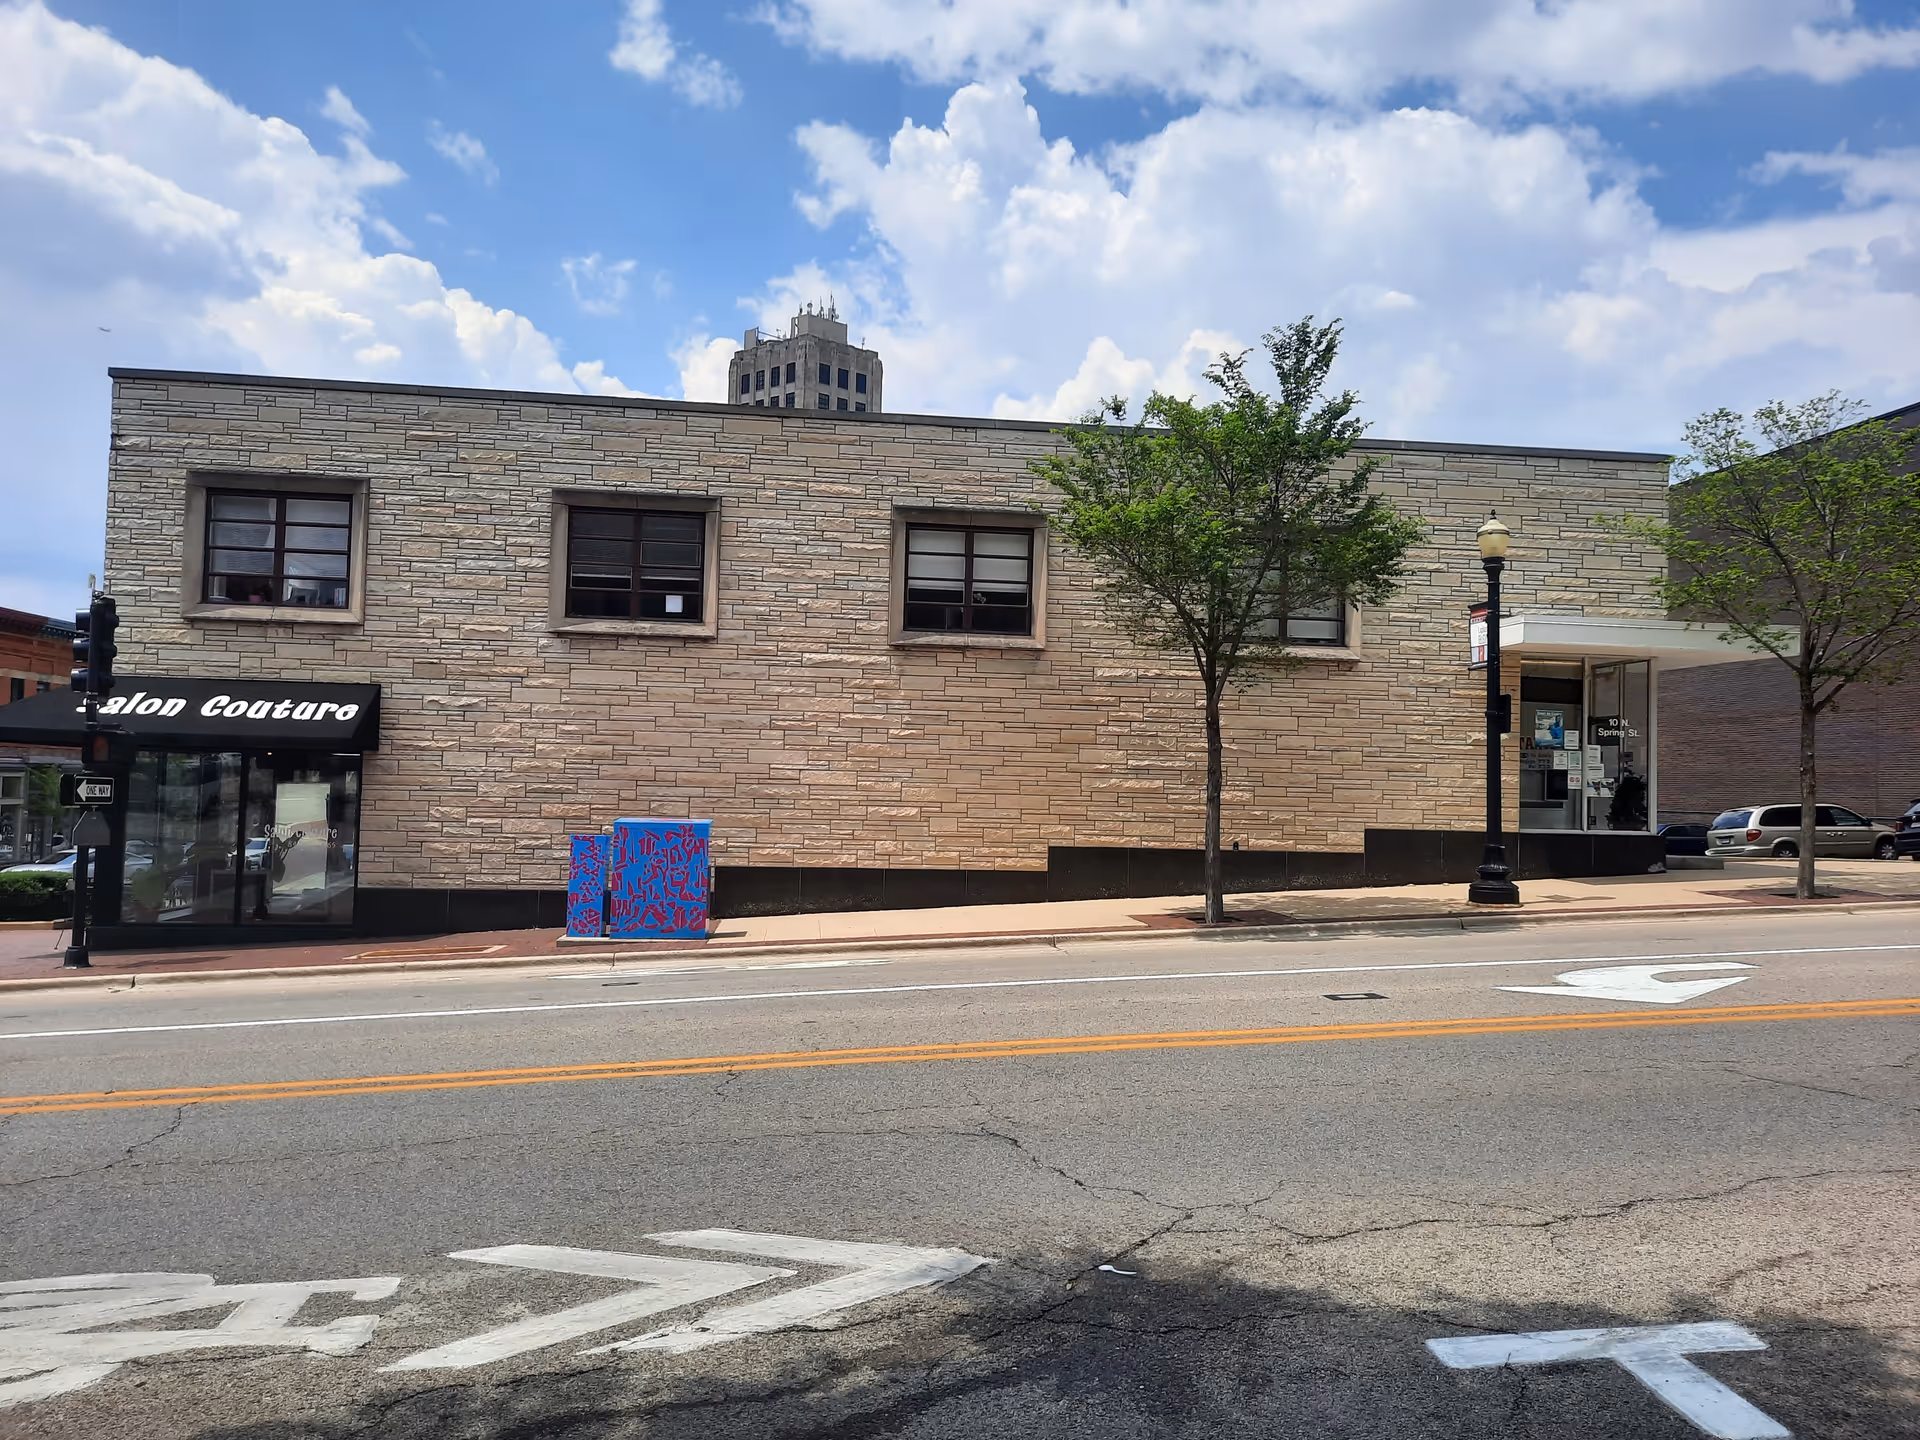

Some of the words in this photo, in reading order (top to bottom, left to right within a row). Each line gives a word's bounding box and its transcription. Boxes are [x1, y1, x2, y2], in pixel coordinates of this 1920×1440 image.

[200, 695, 360, 721] Couture
[1608, 718, 1619, 727] 10
[1598, 728, 1625, 738] Spring
[86, 786, 97, 796] ONE
[98, 786, 110, 796] WAY
